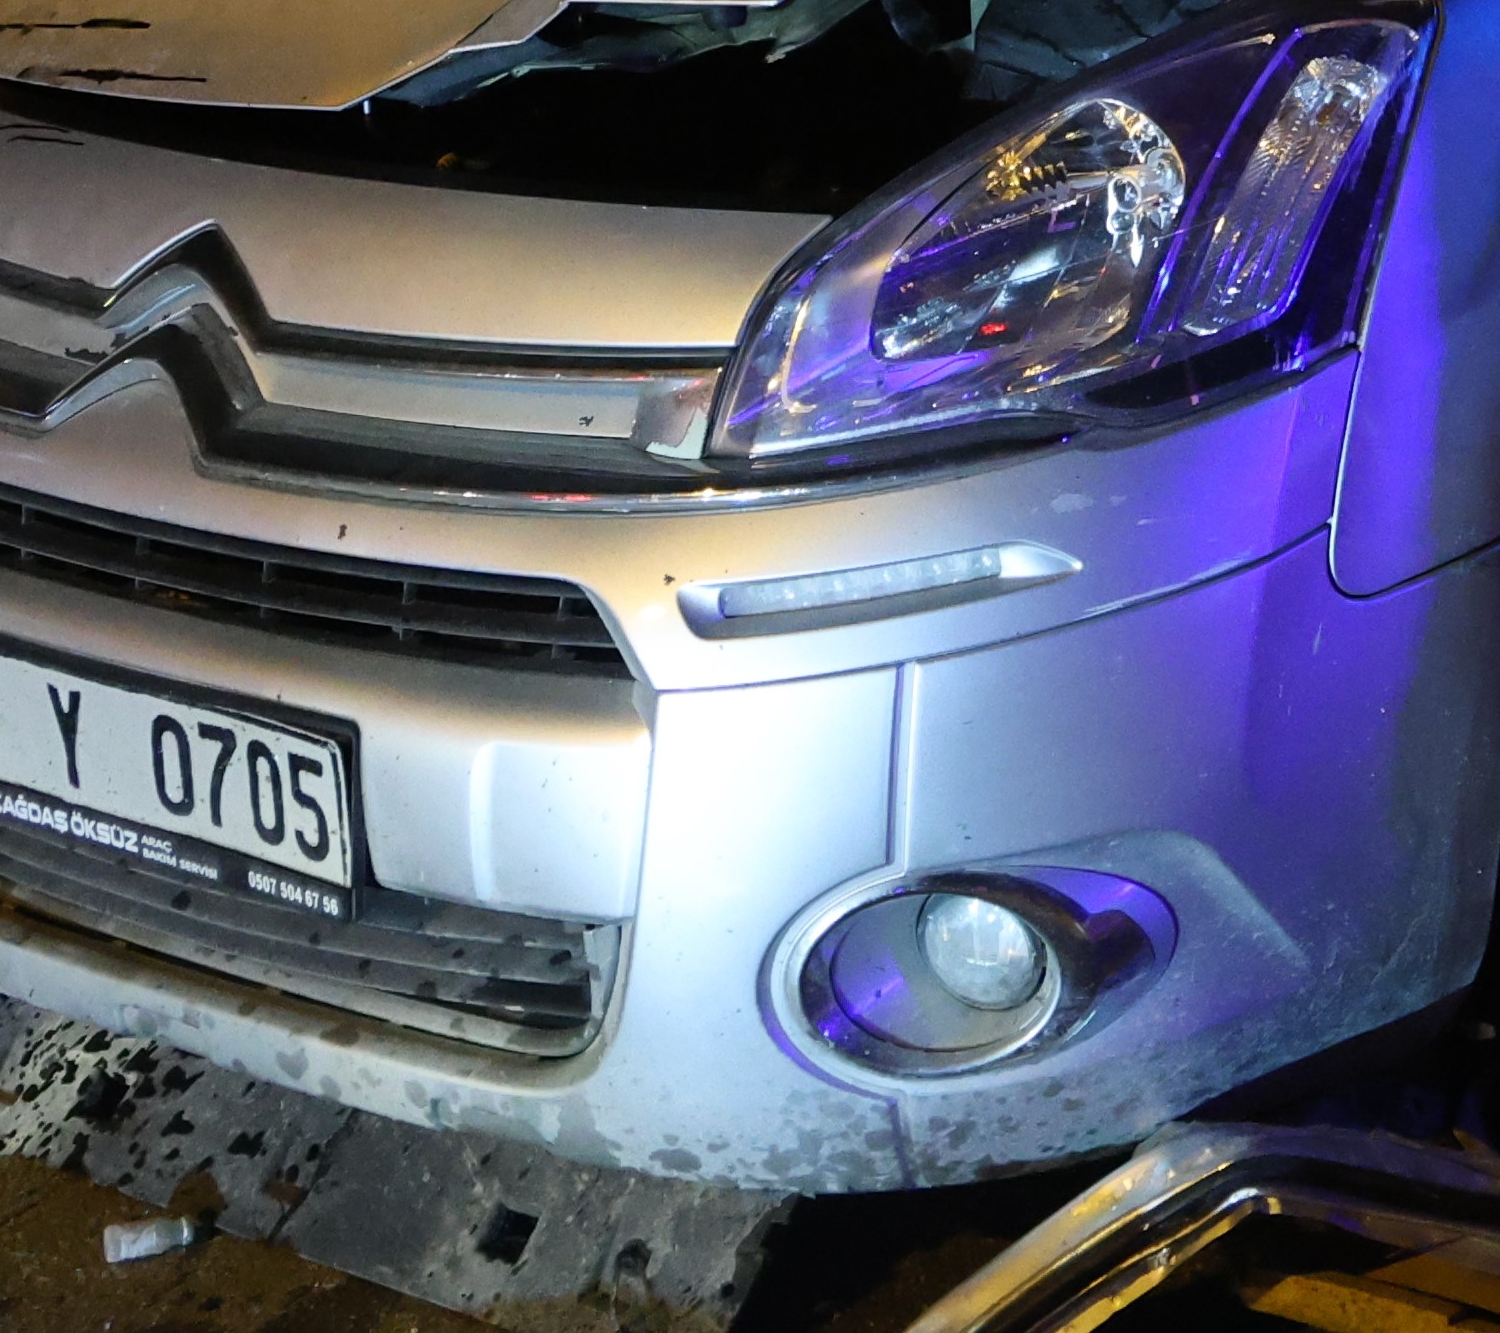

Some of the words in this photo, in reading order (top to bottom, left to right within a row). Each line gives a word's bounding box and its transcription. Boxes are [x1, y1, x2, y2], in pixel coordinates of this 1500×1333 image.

[48, 684, 82, 789] Y
[151, 714, 331, 862] 0705
[70, 811, 140, 854] ÖKSÜZ
[248, 871, 277, 893] 0507
[280, 880, 303, 904] 504
[305, 889, 320, 910] 67
